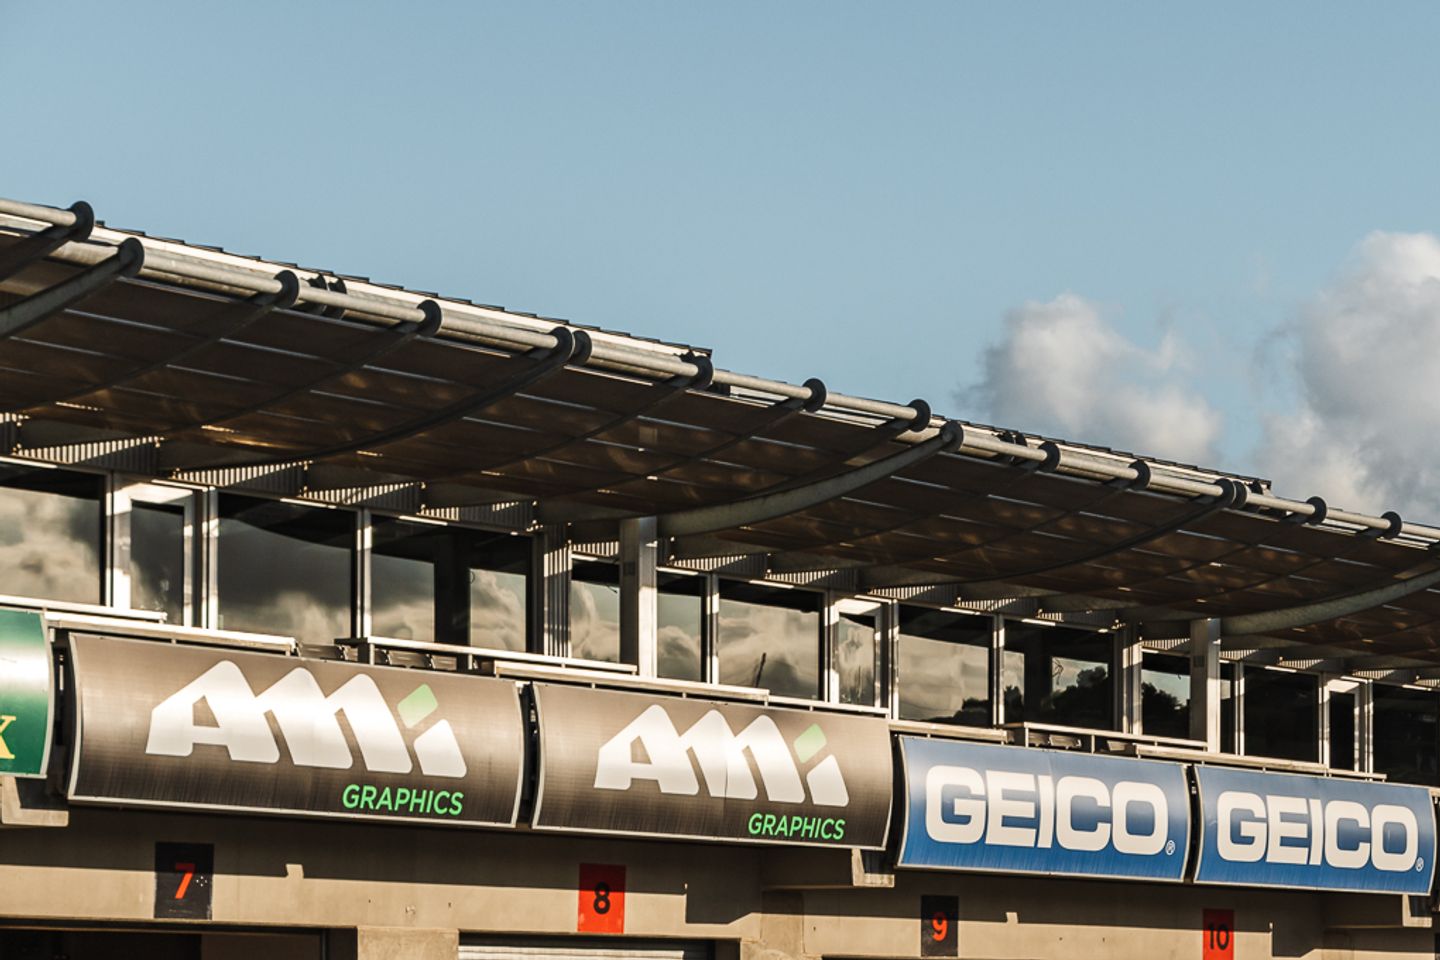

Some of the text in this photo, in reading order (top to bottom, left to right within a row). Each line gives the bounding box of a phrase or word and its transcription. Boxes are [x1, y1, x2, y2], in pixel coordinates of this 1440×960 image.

[342, 784, 464, 815] GRAPHICS
[748, 813, 845, 840] GRAPHICS
[175, 863, 196, 899] 7
[593, 881, 610, 915] 8
[932, 912, 948, 941] 9
[1208, 922, 1230, 950] 10
